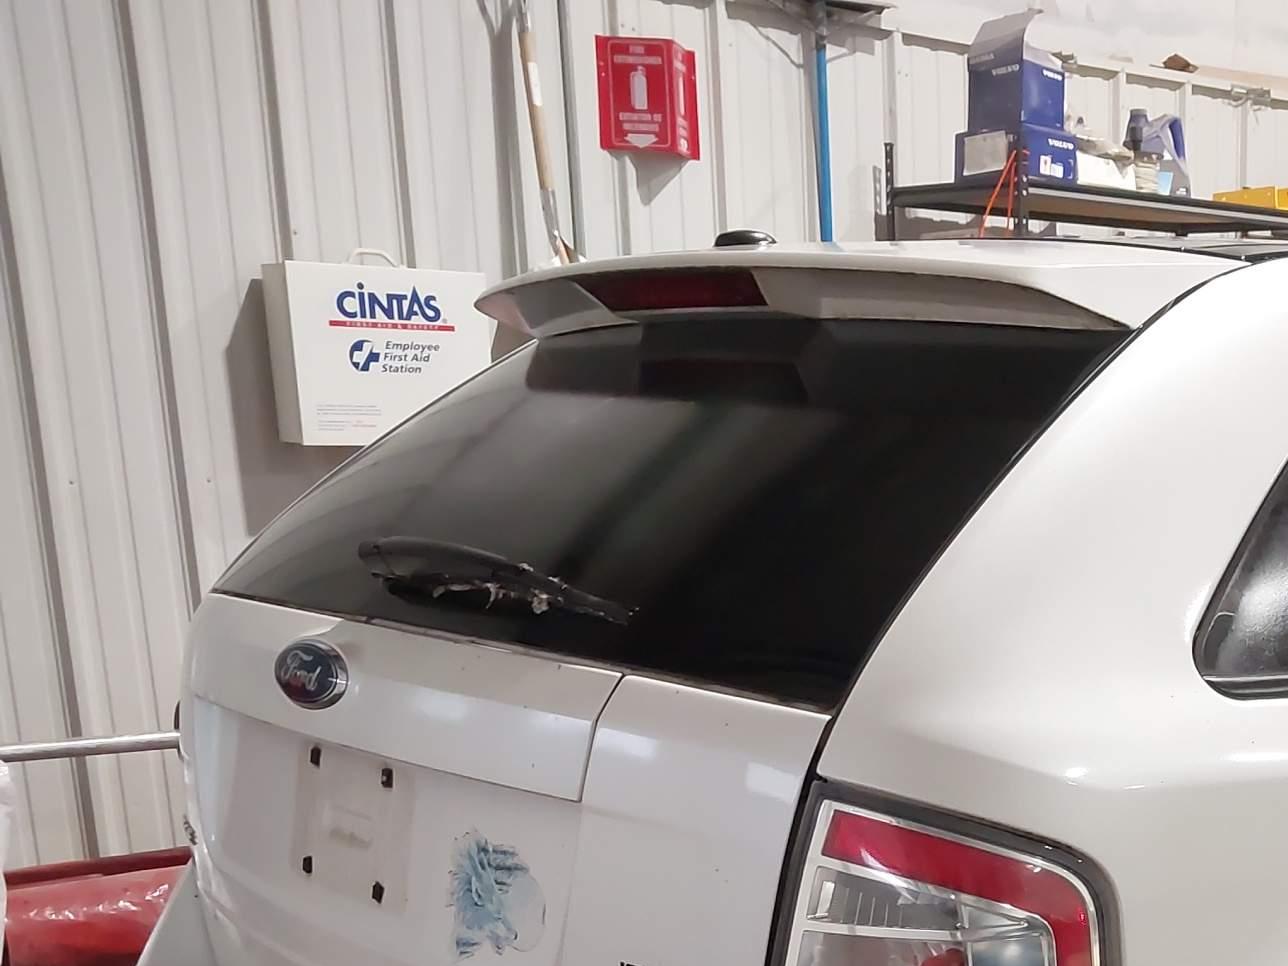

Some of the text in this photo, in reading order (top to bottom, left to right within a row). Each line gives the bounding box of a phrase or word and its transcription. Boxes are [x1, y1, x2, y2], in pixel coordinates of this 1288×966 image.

[1048, 138, 1074, 150] VOLVO
[385, 340, 441, 352] Employee
[383, 352, 431, 363] First Aid
[381, 363, 422, 374] Station
